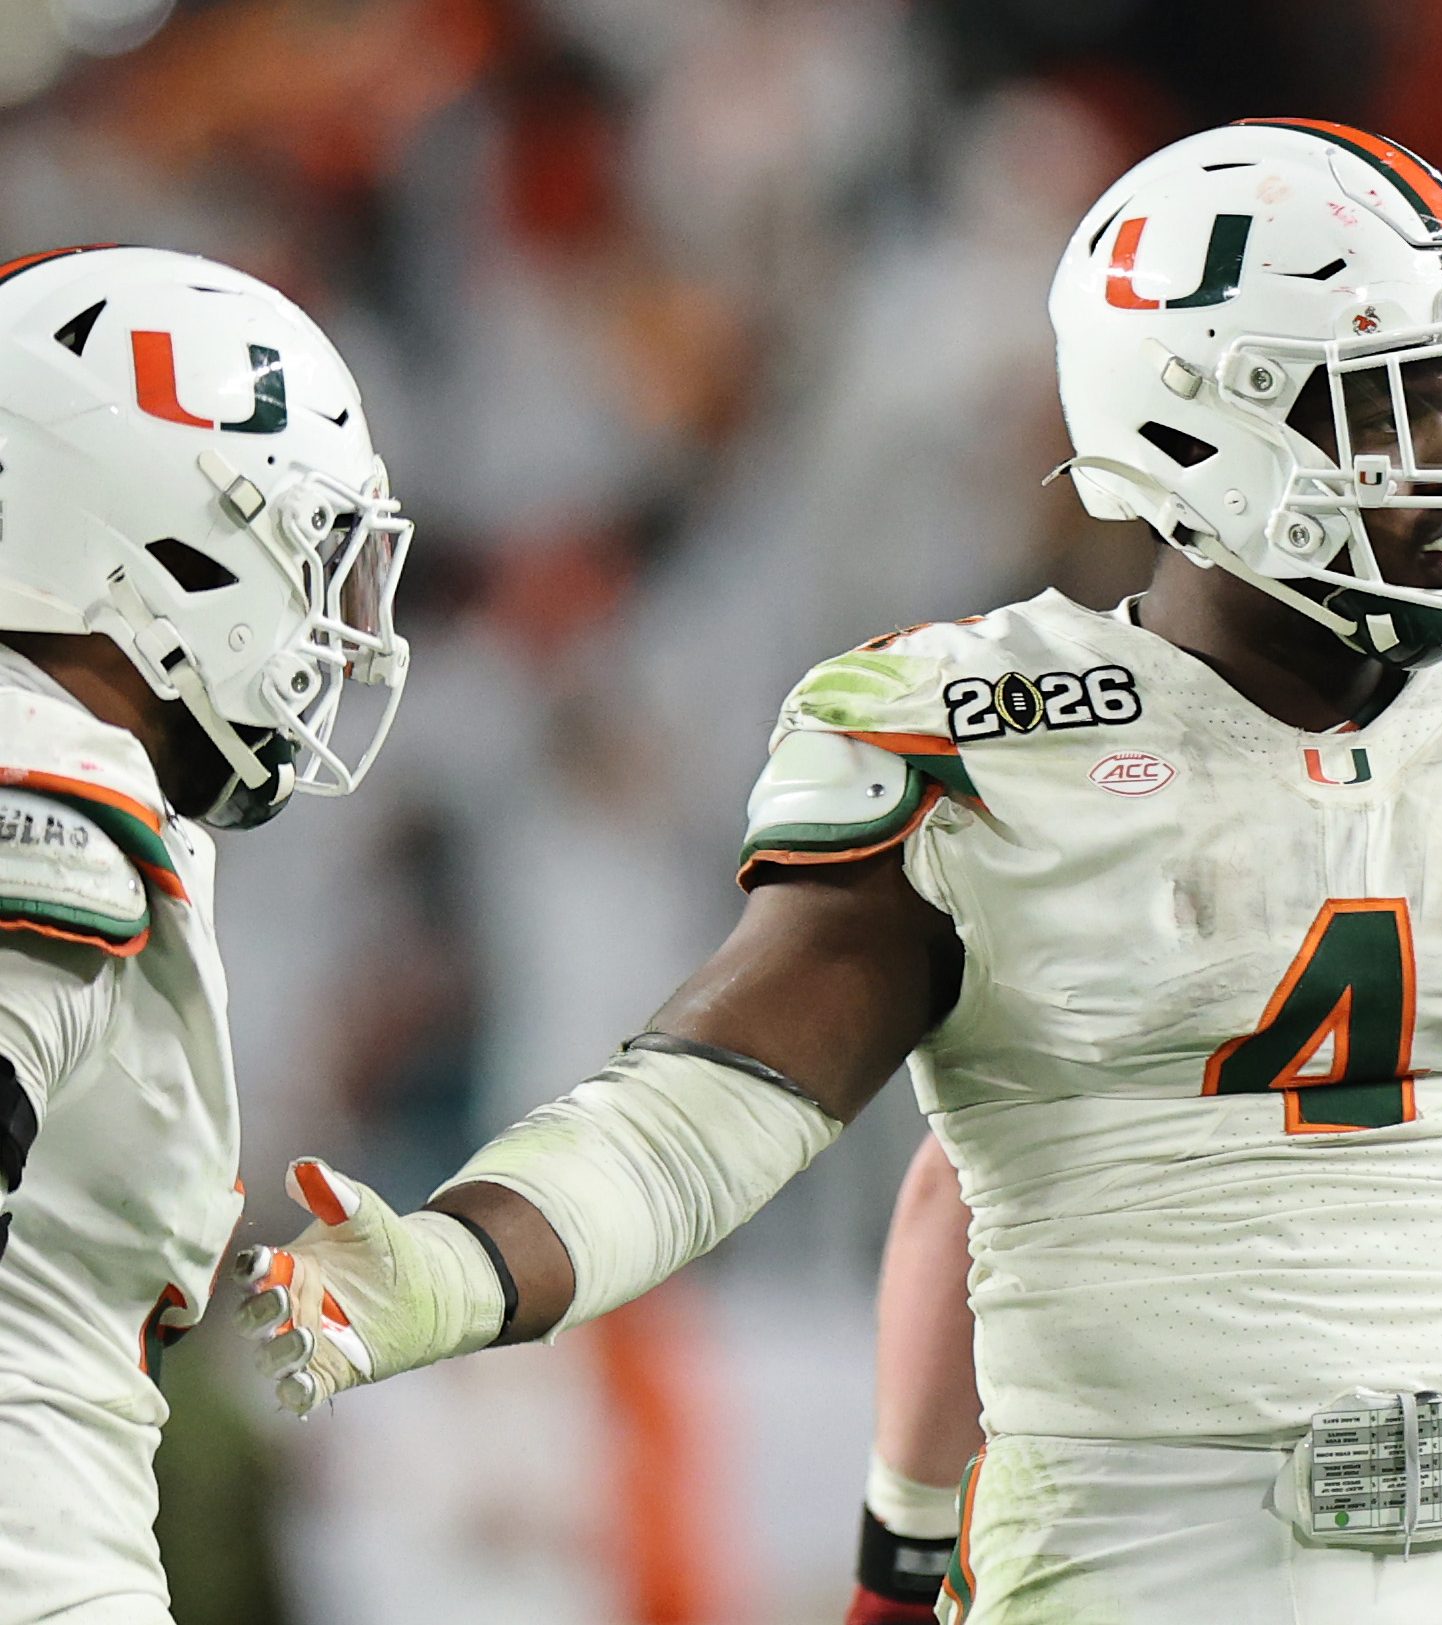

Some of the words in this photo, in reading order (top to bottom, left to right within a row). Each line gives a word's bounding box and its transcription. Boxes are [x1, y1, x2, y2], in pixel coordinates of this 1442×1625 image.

[1105, 213, 1255, 310] U
[130, 329, 288, 435] U
[1360, 471, 1384, 486] U
[1102, 762, 1160, 780] ACC
[1305, 745, 1373, 786] U
[1200, 897, 1419, 1136] 4
